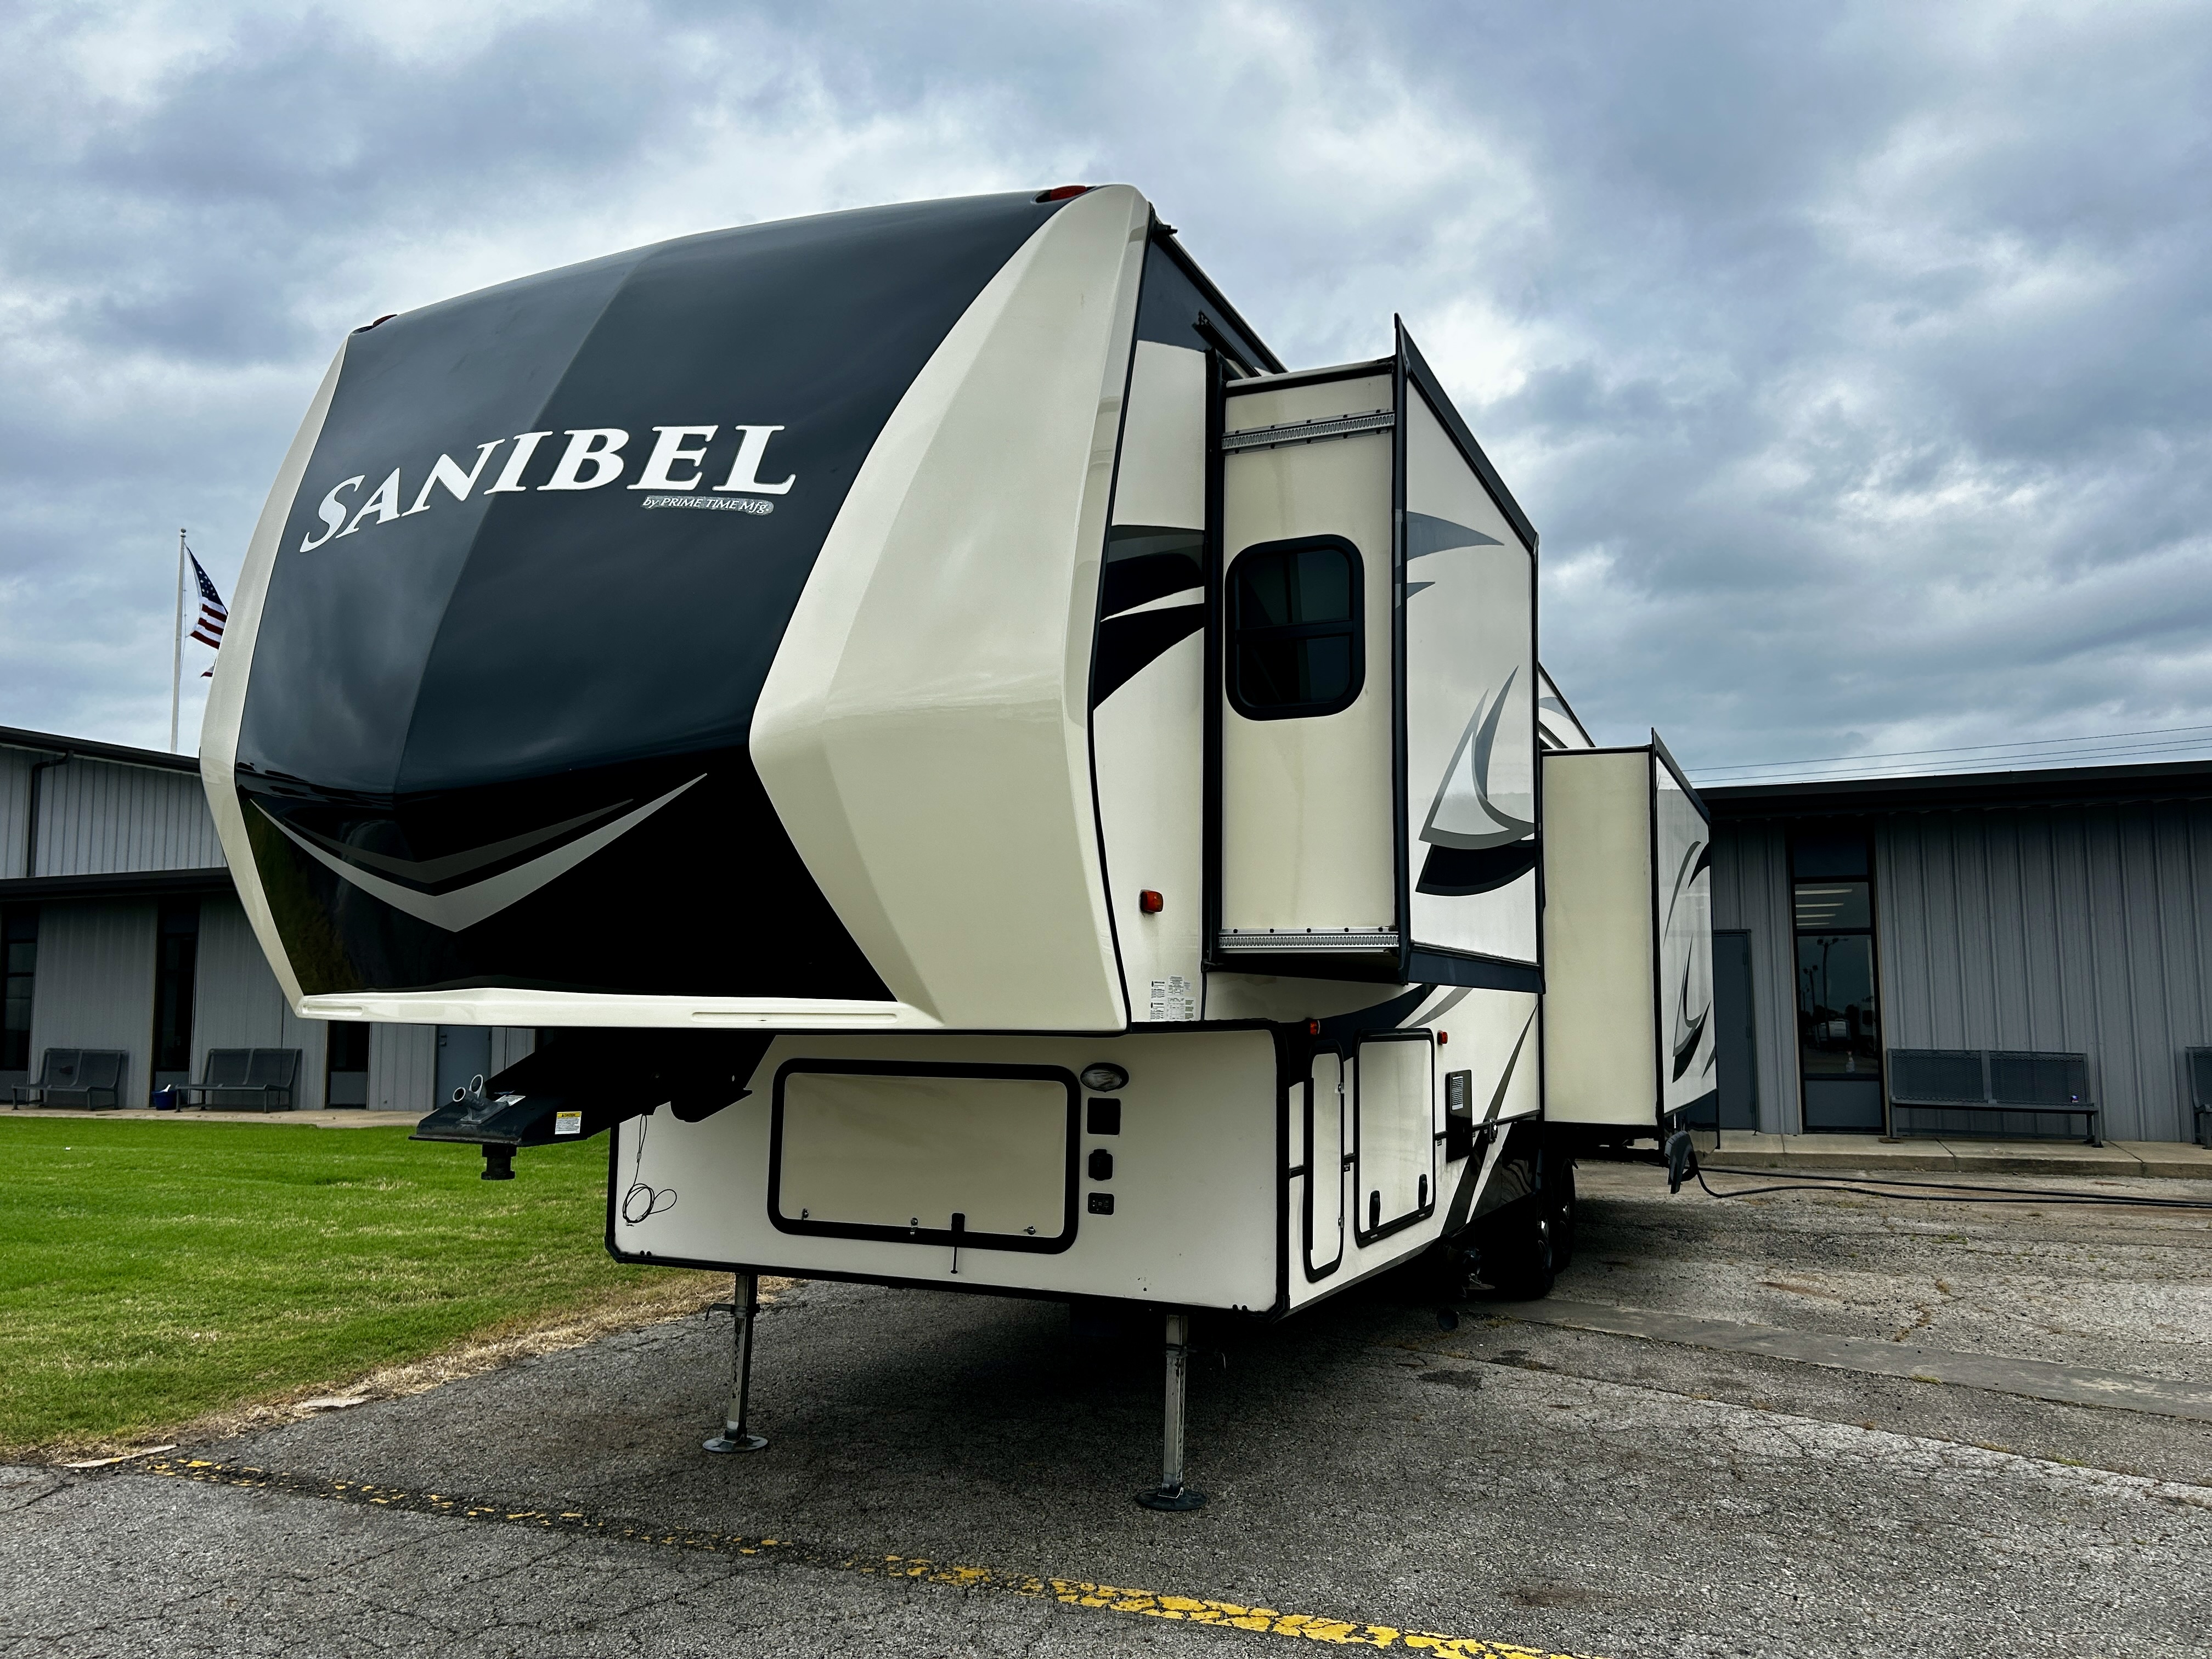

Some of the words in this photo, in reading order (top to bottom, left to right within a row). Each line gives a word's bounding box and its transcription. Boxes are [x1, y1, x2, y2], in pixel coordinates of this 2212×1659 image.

[300, 425, 796, 552] SANIBEL
[642, 497, 659, 508] by
[661, 498, 703, 507] PRIME
[706, 499, 739, 509] TIME
[740, 501, 769, 514] Mfg.
